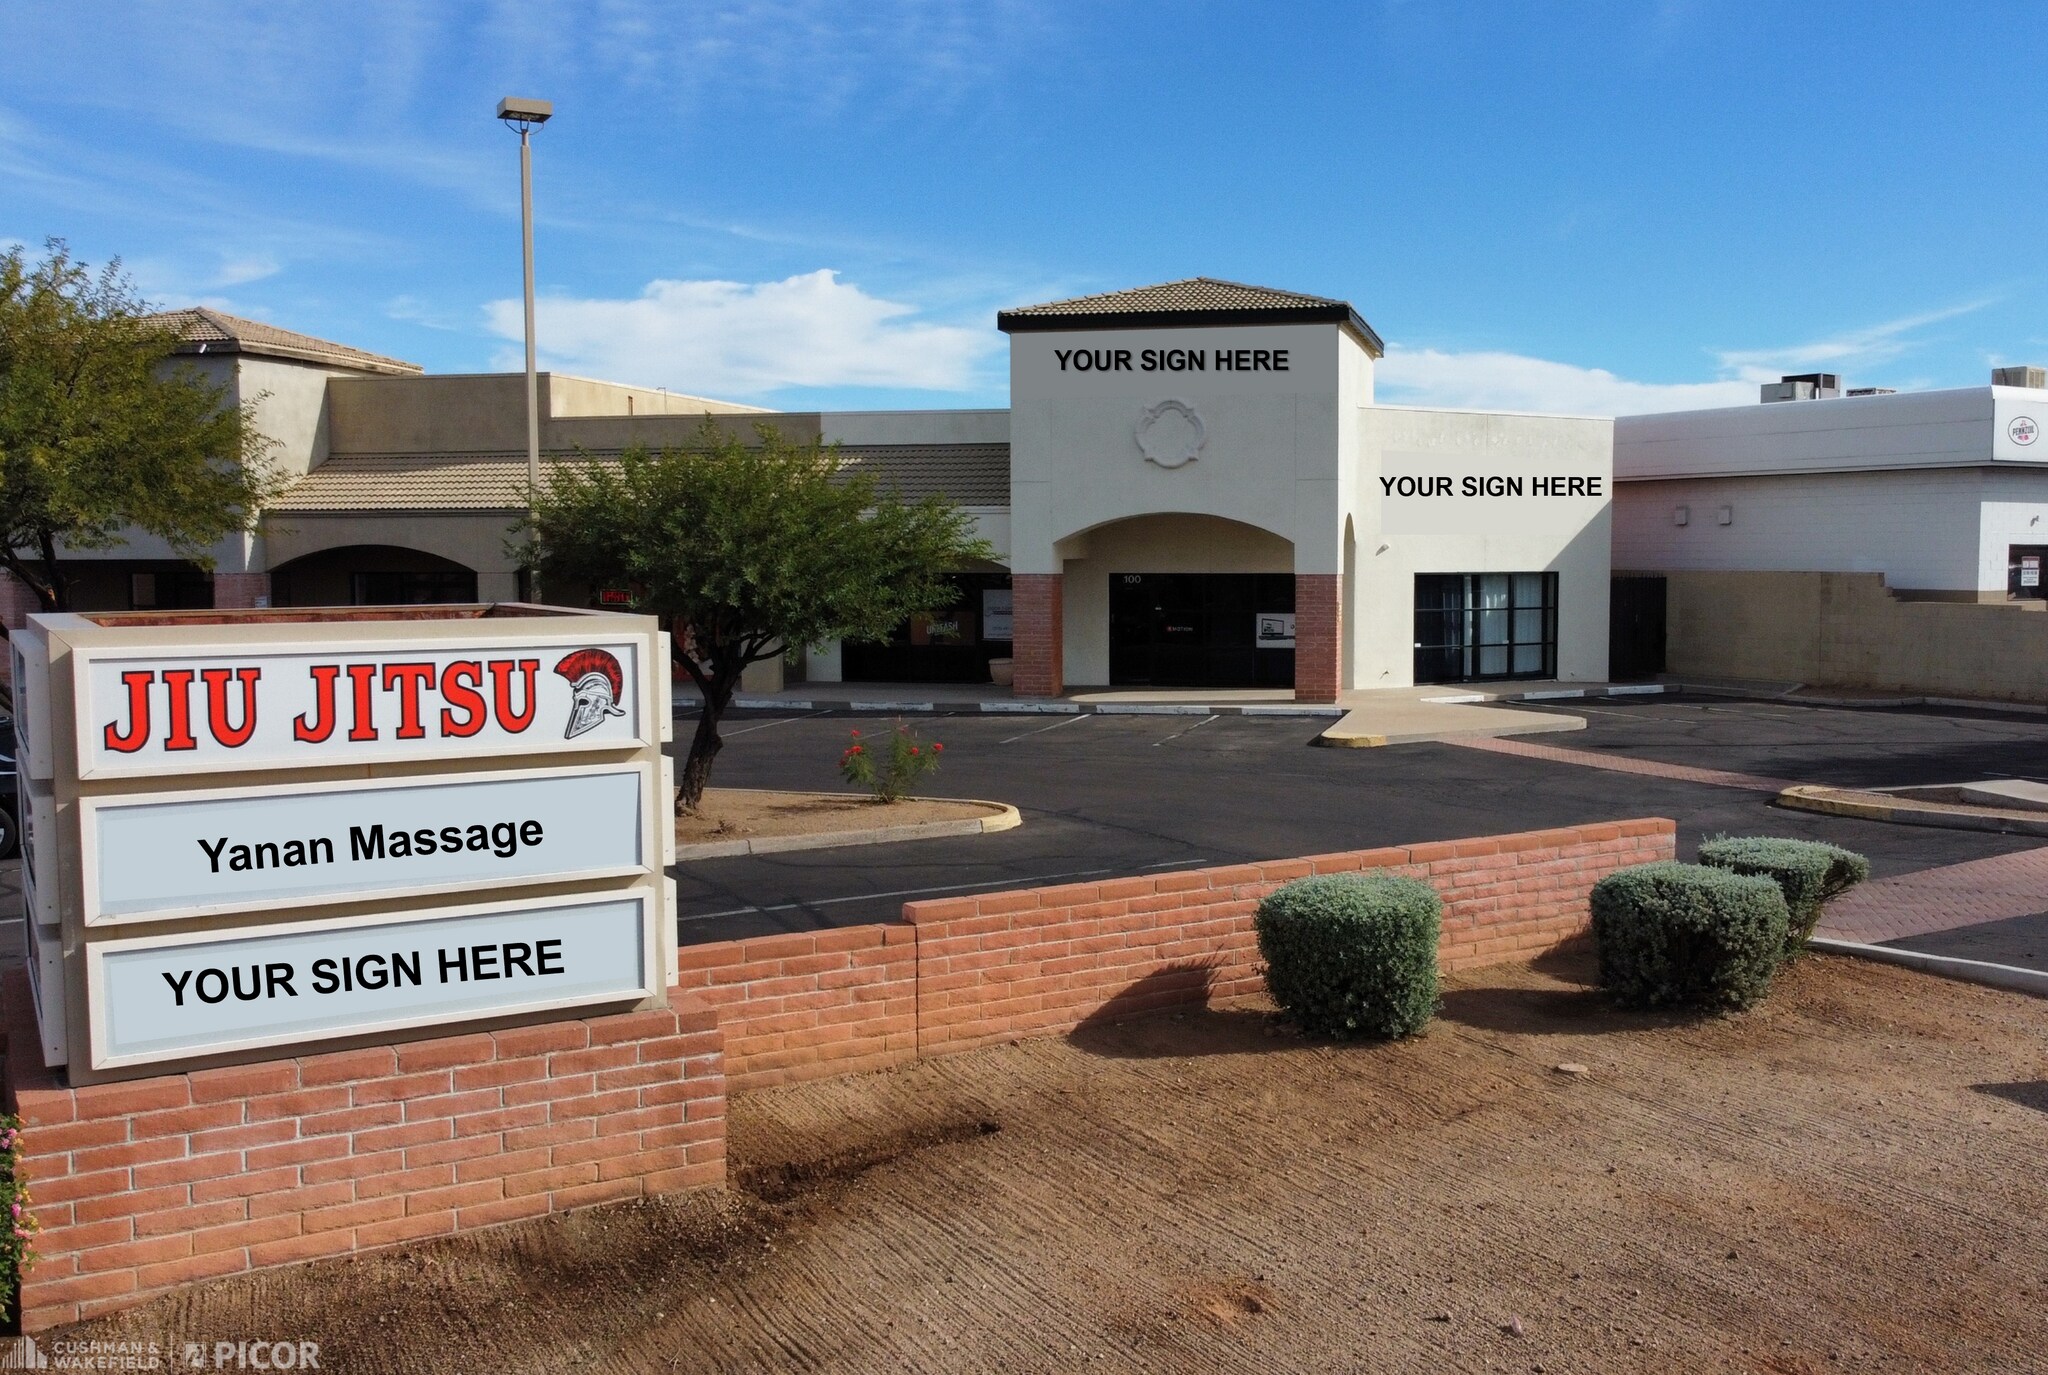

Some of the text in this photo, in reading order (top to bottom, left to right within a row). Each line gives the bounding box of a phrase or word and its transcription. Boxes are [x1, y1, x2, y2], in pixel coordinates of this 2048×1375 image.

[1054, 349, 1290, 372] YOUR SIGN HERE
[1379, 476, 1603, 498] YOUR SIGN HERE
[1123, 575, 1141, 583] 100
[104, 658, 541, 753] JIU JITSU
[196, 820, 545, 874] Yanan Massage
[161, 939, 565, 1007] YOUR SIGN HERE
